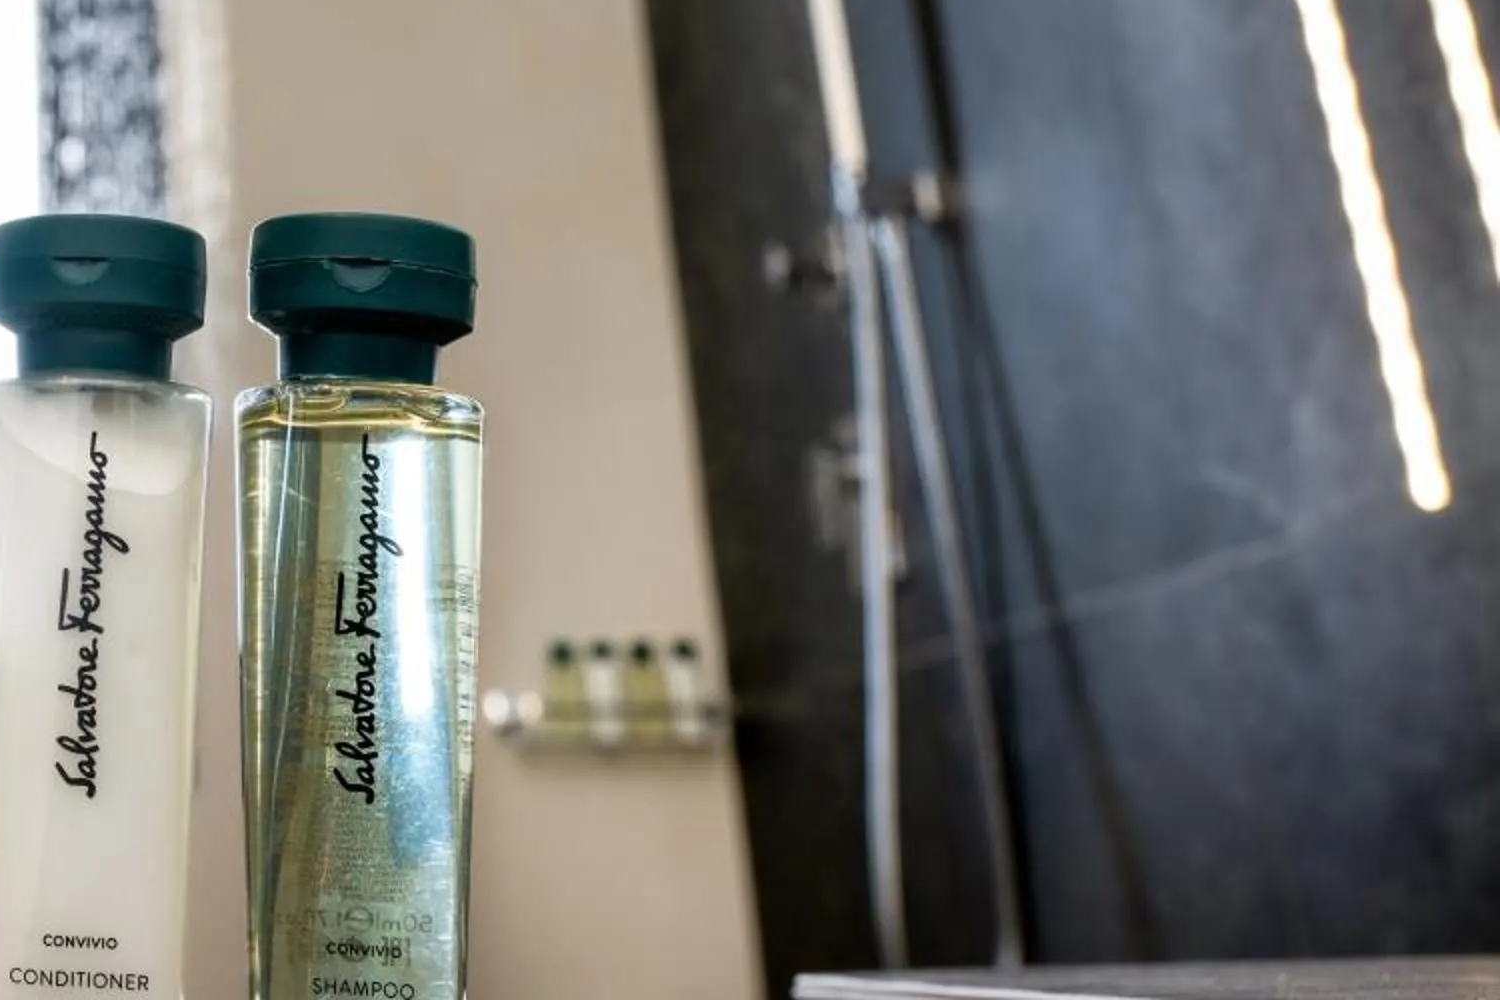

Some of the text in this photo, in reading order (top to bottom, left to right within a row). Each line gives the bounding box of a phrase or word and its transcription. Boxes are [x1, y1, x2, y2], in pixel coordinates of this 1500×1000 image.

[335, 434, 404, 637] Ferragamo
[55, 432, 130, 799] Salvatore Ferragamo
[333, 644, 378, 804] Salvatore
[42, 933, 118, 950] CONVIVIO
[325, 940, 402, 959] CONVIVIO
[9, 967, 149, 991] CONDITIONER
[311, 977, 416, 1000] SHAMPOO
